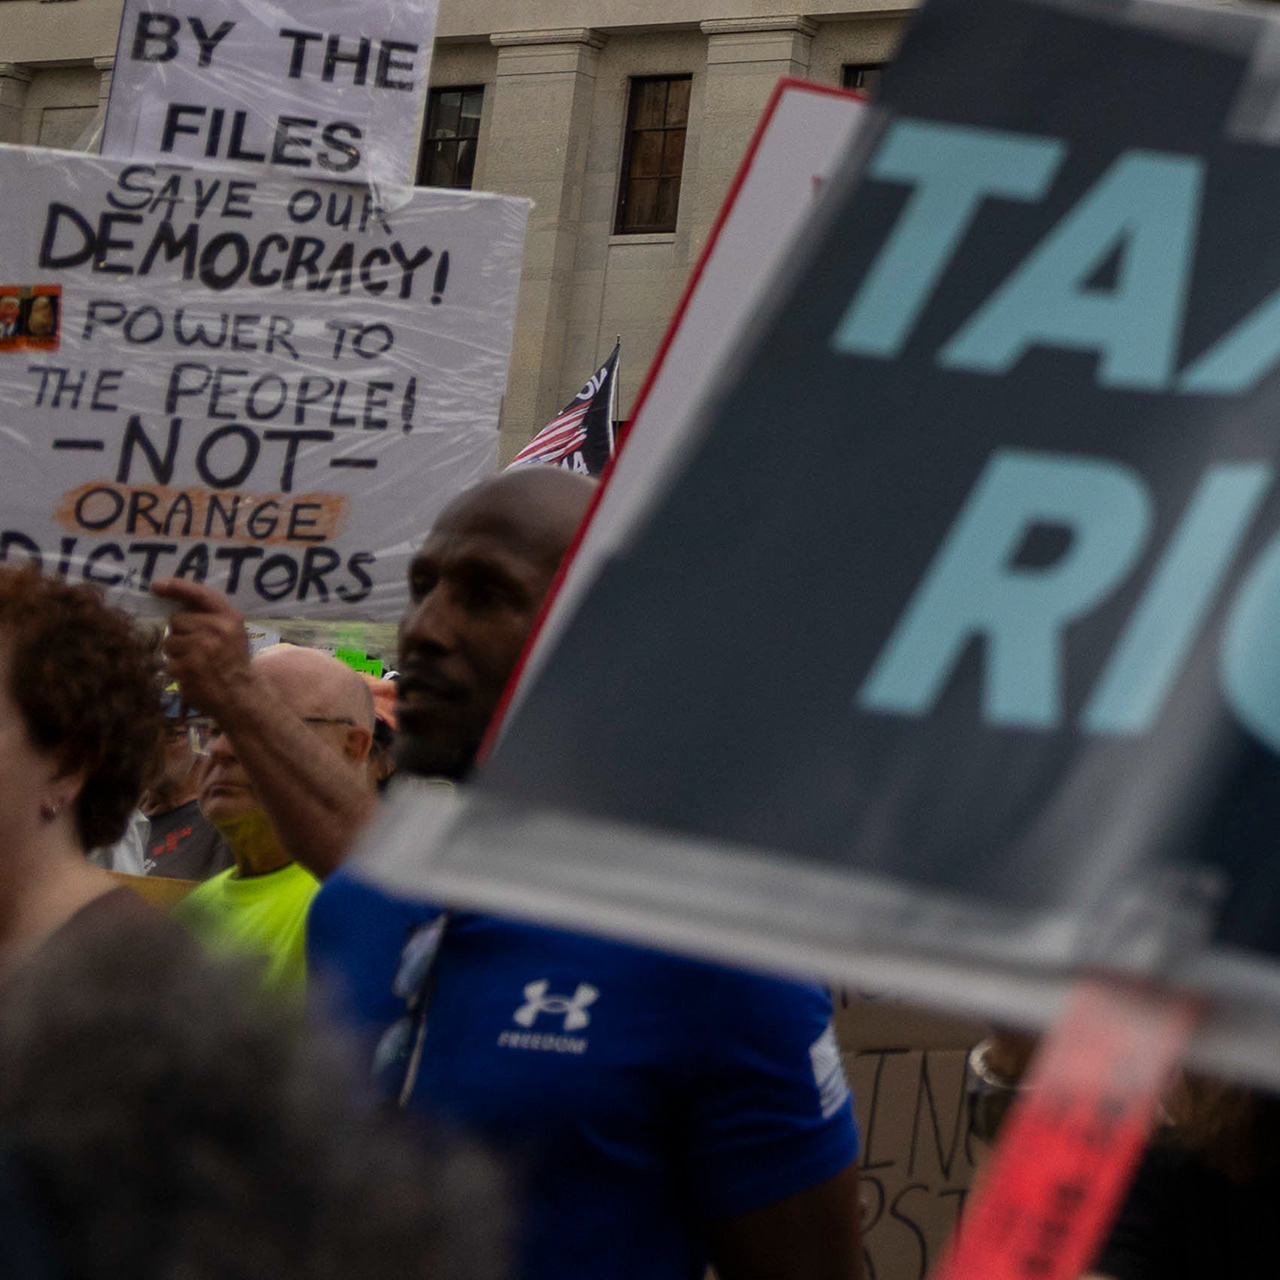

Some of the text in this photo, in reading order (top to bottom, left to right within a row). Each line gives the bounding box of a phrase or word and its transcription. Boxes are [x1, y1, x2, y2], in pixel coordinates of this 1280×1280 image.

[130, 11, 419, 91] BY THE
[160, 102, 364, 172] FILES
[107, 164, 392, 234] SAVE OUR
[38, 202, 450, 305] DEMOCRACY!
[82, 300, 394, 360] POWER TO
[28, 362, 417, 434] THE PEOPLE!
[74, 487, 327, 541] ORANGE
